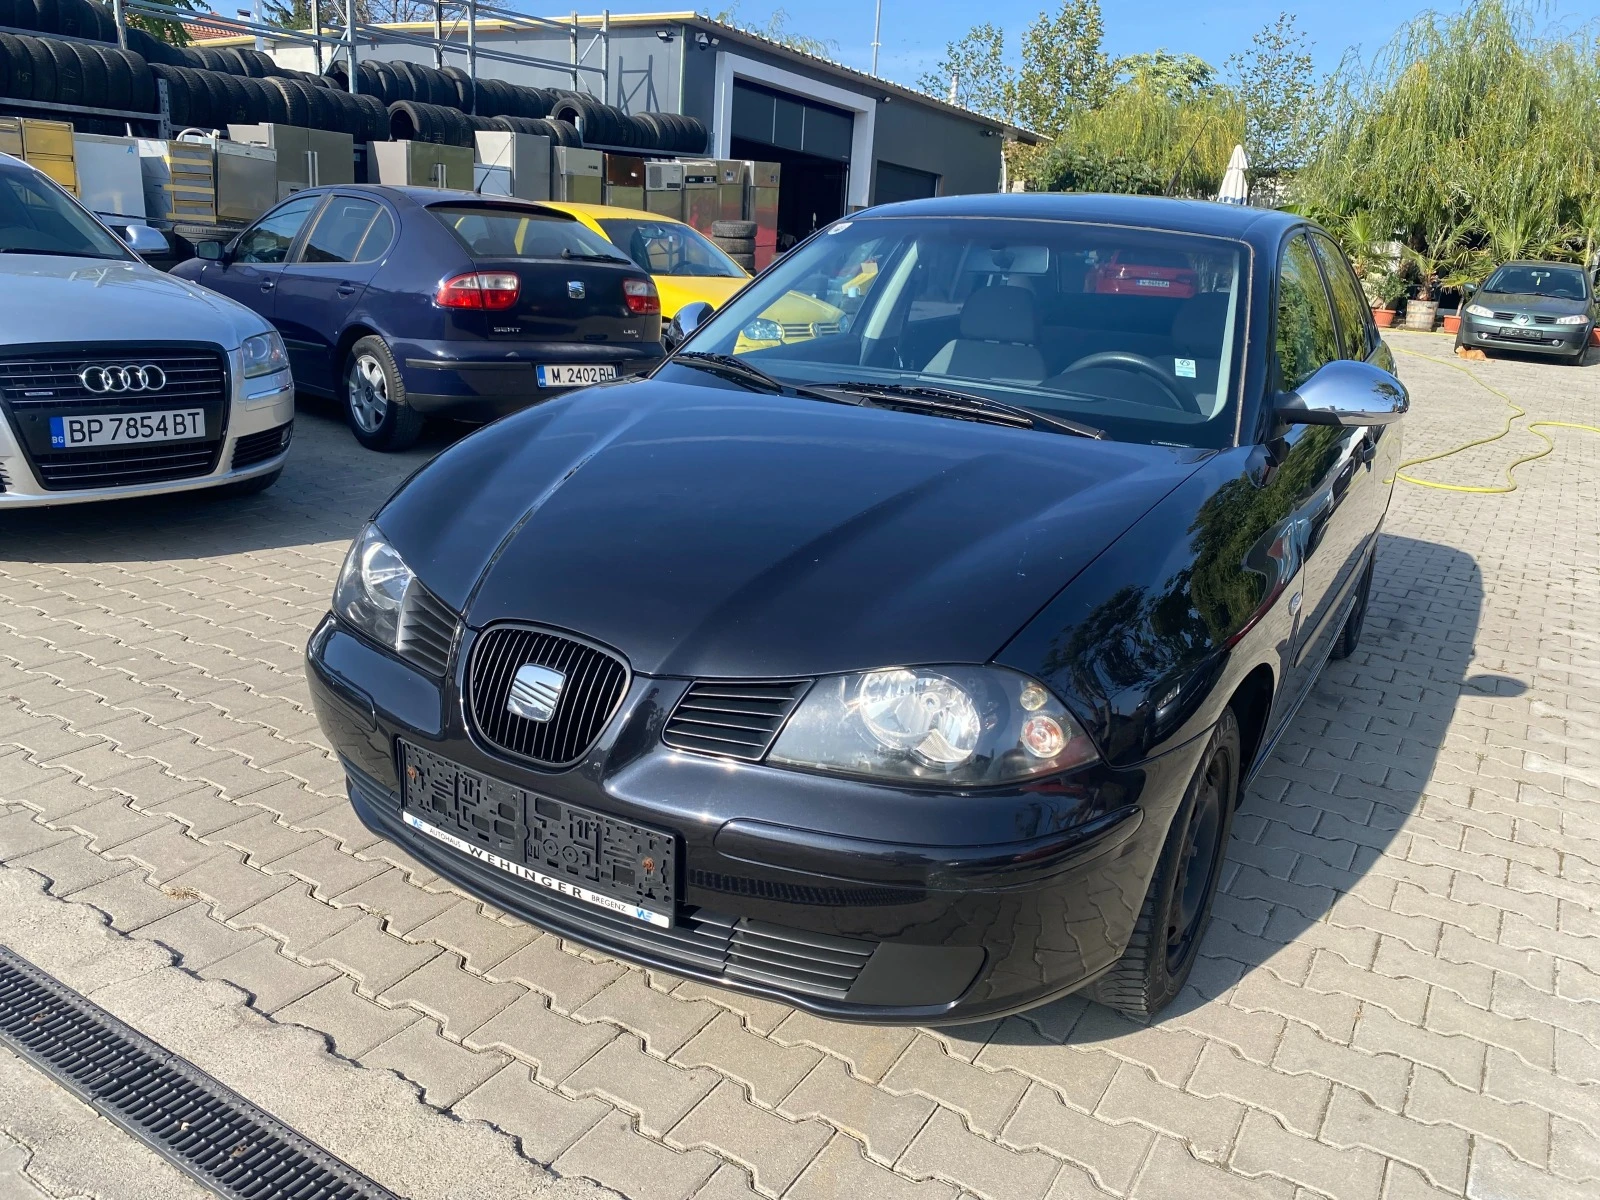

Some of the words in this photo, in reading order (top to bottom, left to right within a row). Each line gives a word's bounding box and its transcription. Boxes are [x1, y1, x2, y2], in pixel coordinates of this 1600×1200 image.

[68, 419, 103, 443] BP
[109, 415, 169, 440] 7854
[173, 411, 200, 436] BT
[429, 828, 461, 848] AUTOHAUS
[468, 844, 582, 899] WEHINGER
[591, 894, 627, 912] BREGENZ
